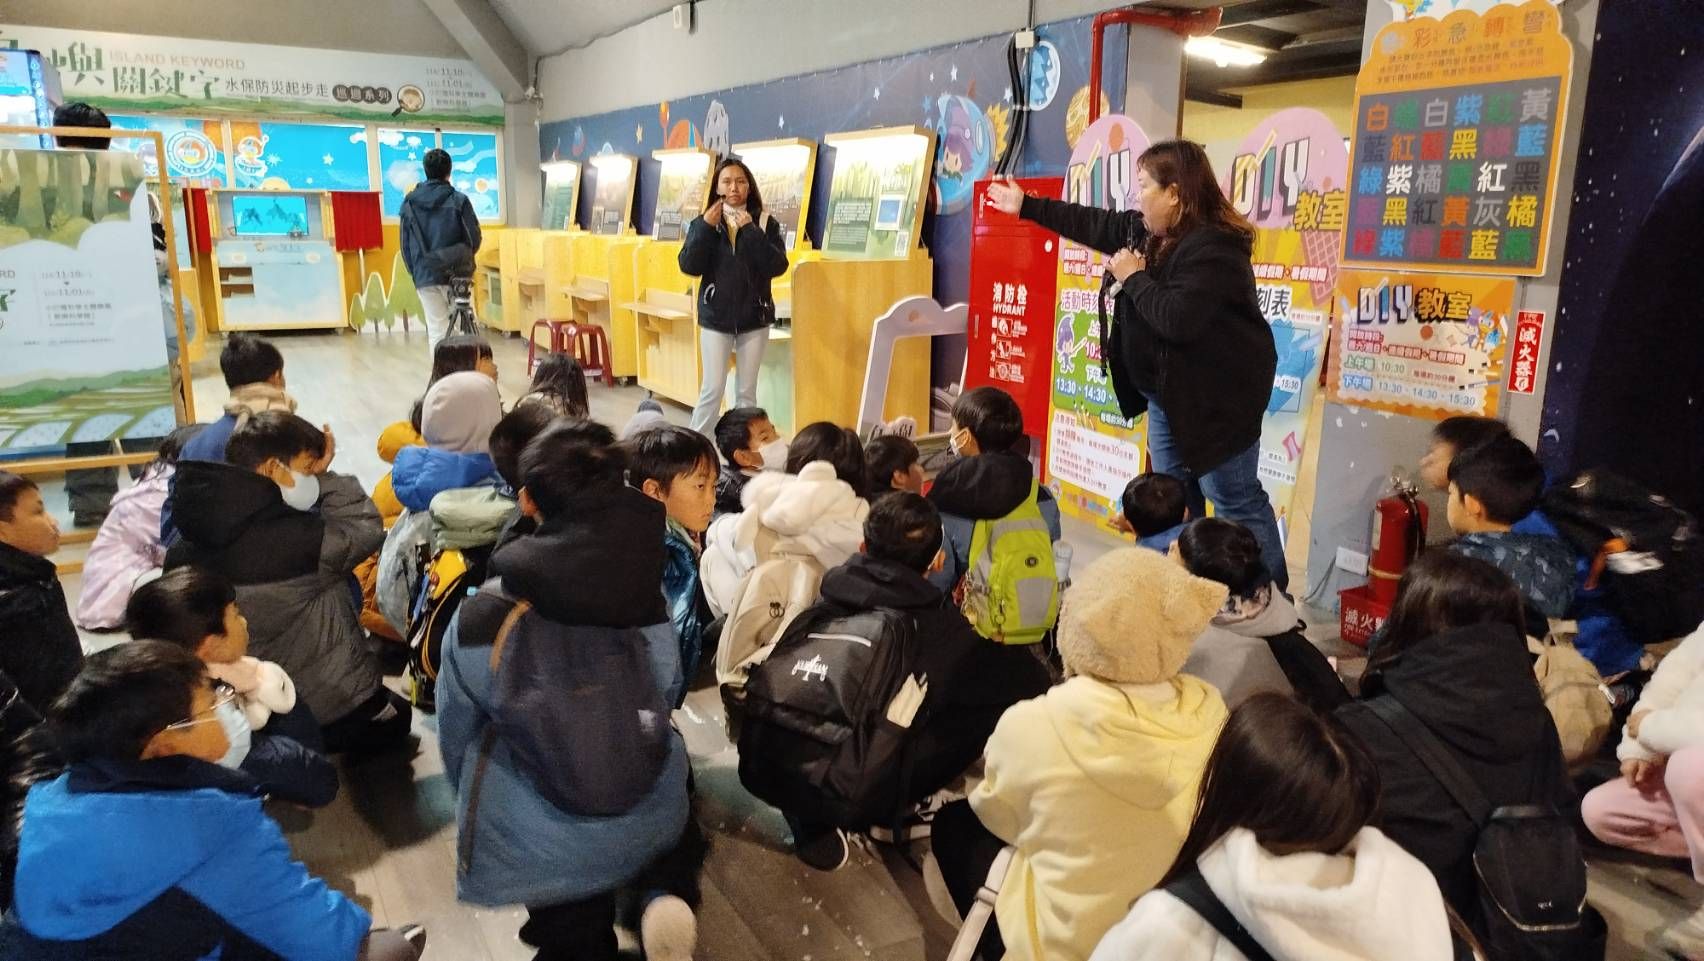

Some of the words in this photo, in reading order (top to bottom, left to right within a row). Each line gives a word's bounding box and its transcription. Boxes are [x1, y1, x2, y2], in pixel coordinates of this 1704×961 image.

[109, 50, 166, 66] ISLAND
[169, 53, 246, 71] KEYWORD
[224, 77, 329, 98] 水保防災起步走
[1230, 137, 1310, 221] DIY
[1293, 188, 1345, 232] 教室
[992, 281, 1028, 305] 消防栓
[1357, 284, 1413, 322] DIY
[992, 302, 1026, 316] HYDRANT
[1416, 287, 1472, 323] 教室
[1381, 361, 1405, 374] 10:30
[1280, 379, 1299, 390] 15:30
